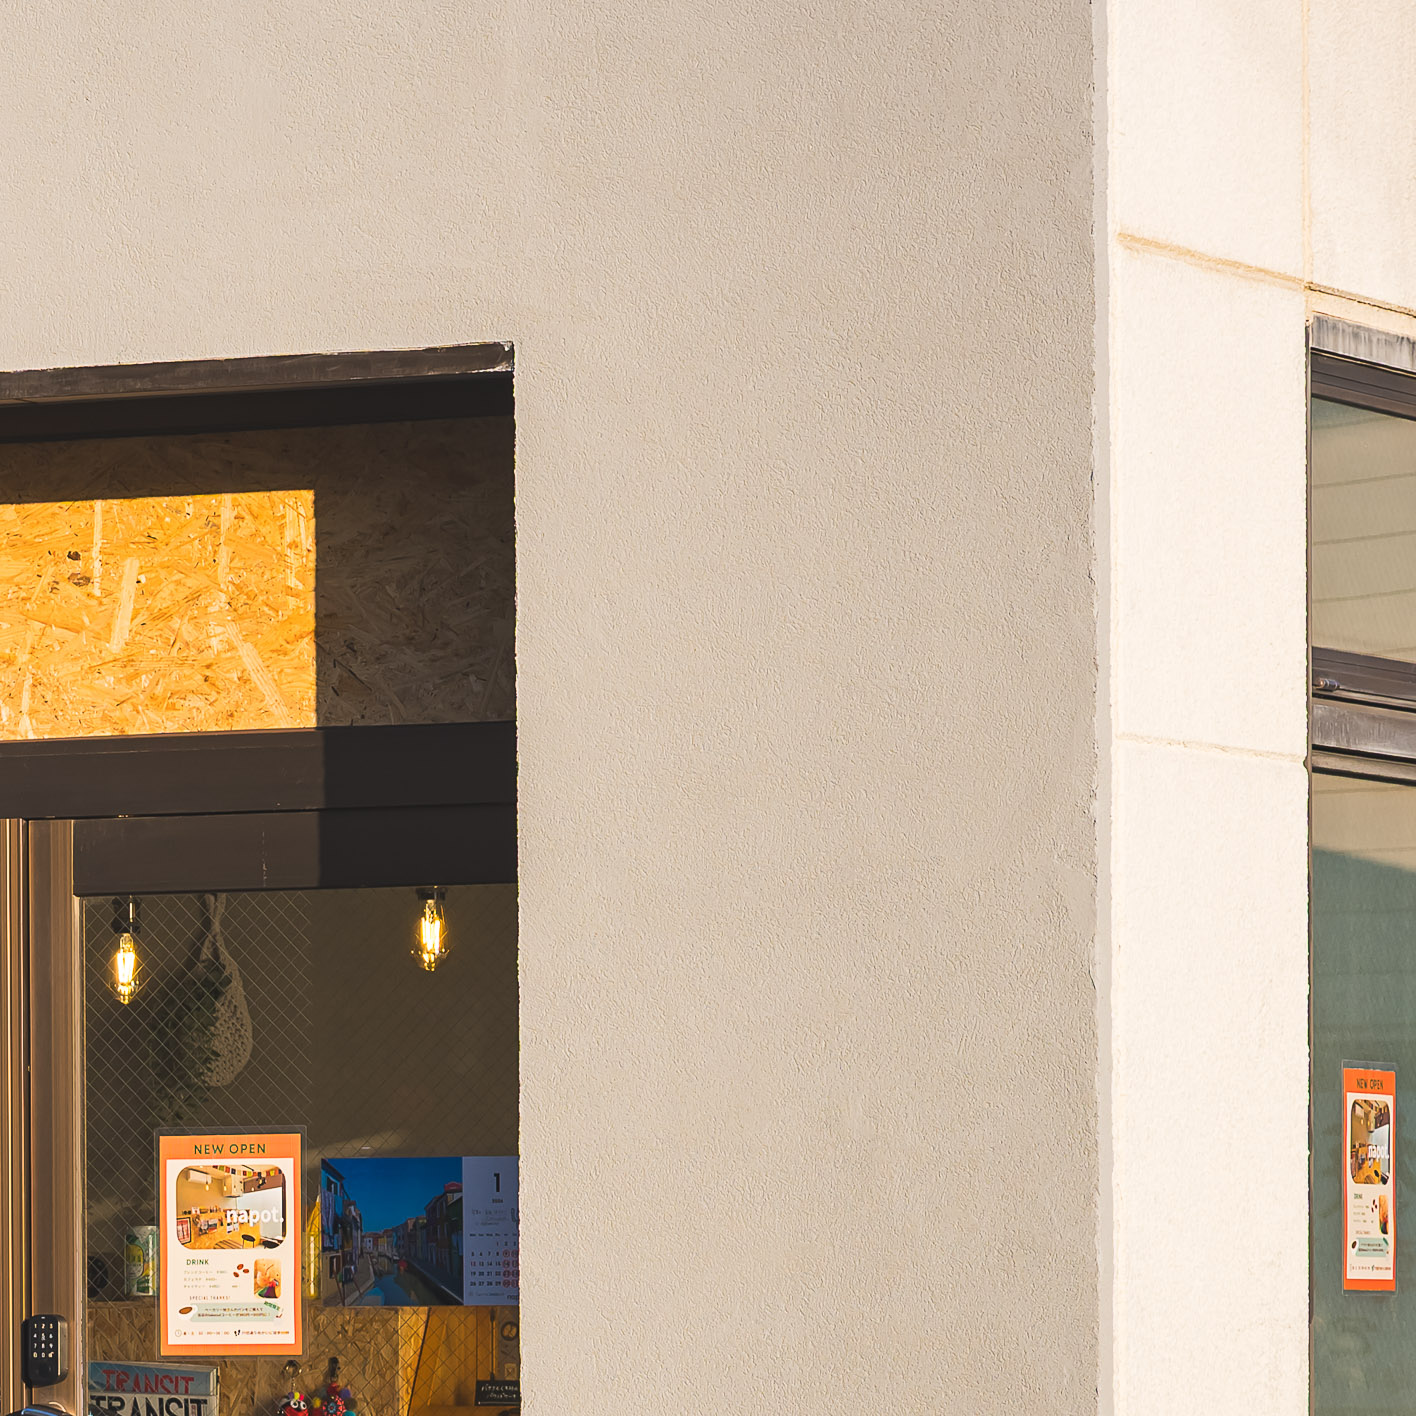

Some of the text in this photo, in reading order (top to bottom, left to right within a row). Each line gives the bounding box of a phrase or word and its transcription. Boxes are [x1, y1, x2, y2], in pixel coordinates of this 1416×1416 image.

[1357, 1078, 1384, 1090] NEW OPEN
[194, 1143, 266, 1154] NEW OPEN
[1368, 1144, 1390, 1162] napot.
[493, 1172, 501, 1193] 1
[226, 1206, 285, 1227] napot.
[102, 1369, 195, 1394] TRANSIT
